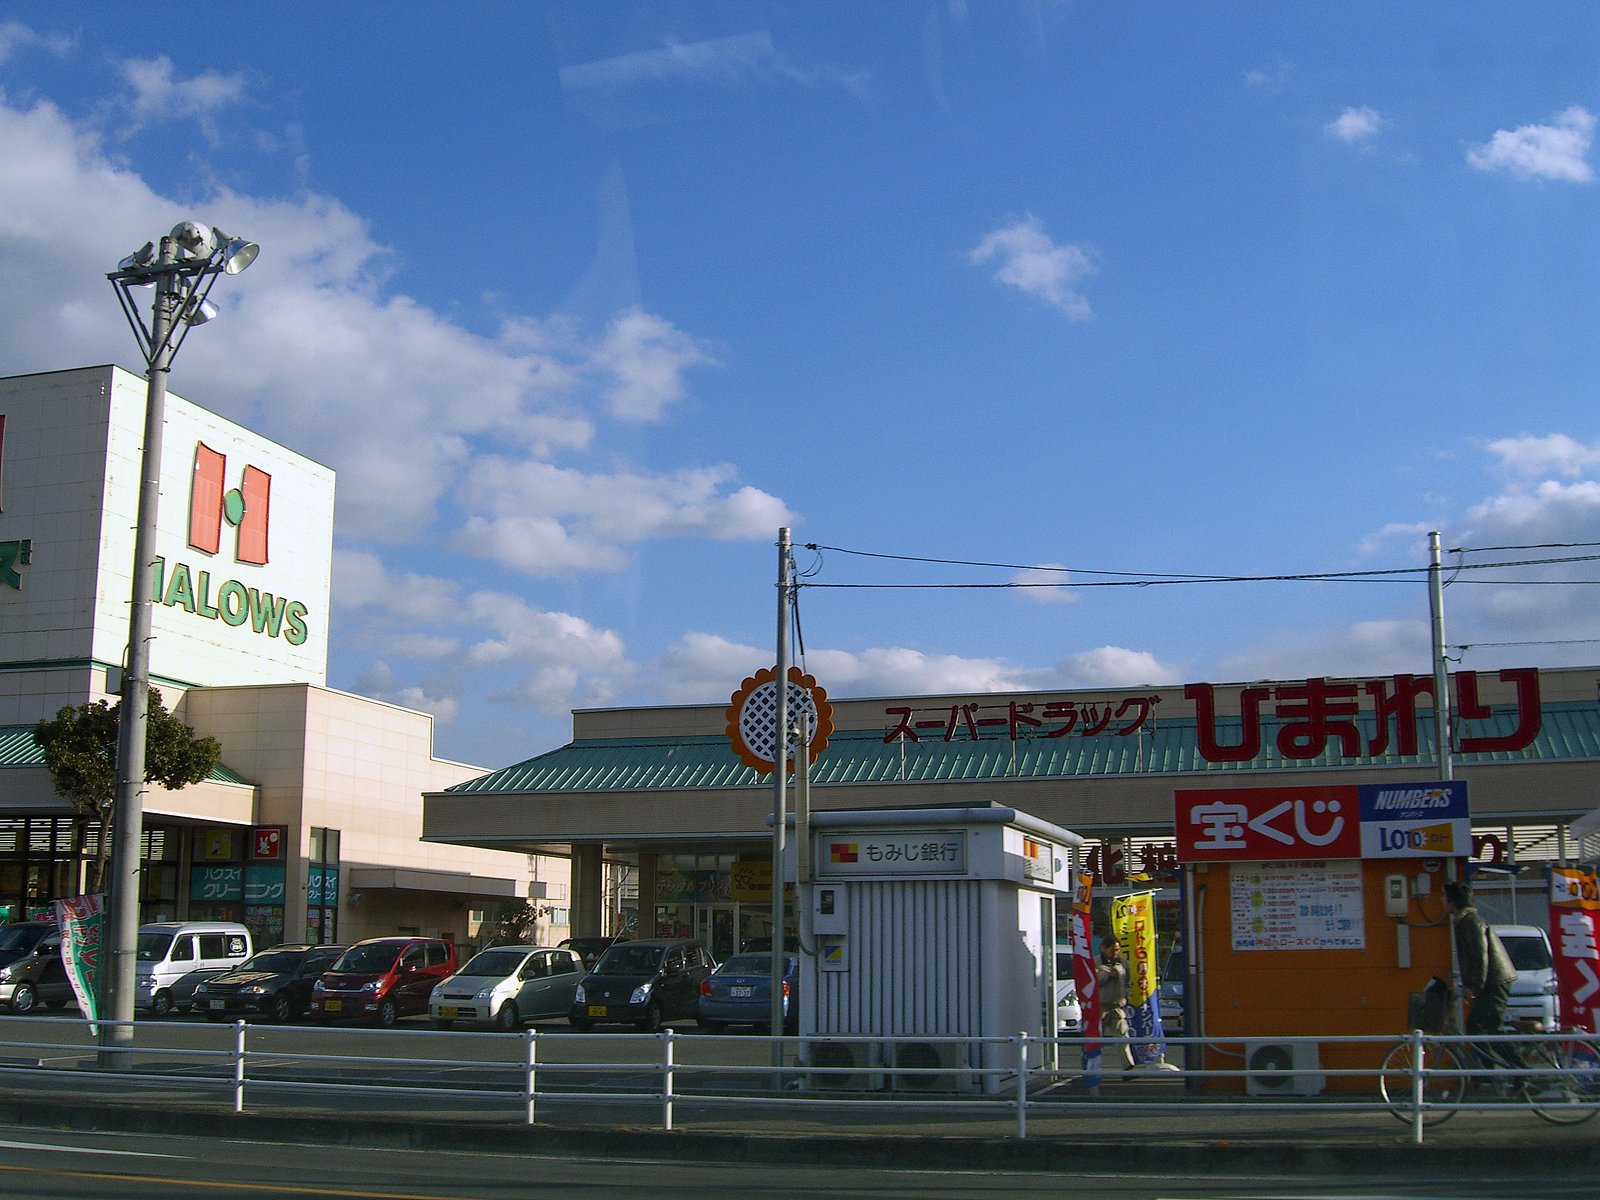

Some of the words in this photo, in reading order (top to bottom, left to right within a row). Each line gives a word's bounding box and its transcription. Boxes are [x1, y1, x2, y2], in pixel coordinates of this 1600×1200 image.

[884, 695, 1162, 744] スーパードラッグ
[1184, 667, 1541, 763] ひまわり
[1373, 788, 1453, 811] NUMBERS
[1190, 800, 1345, 850] 宝くじ
[1379, 826, 1422, 853] LOTO
[866, 842, 958, 862] もみじ銀行
[204, 868, 242, 881] ハクスイ
[204, 883, 284, 899] クリーニング
